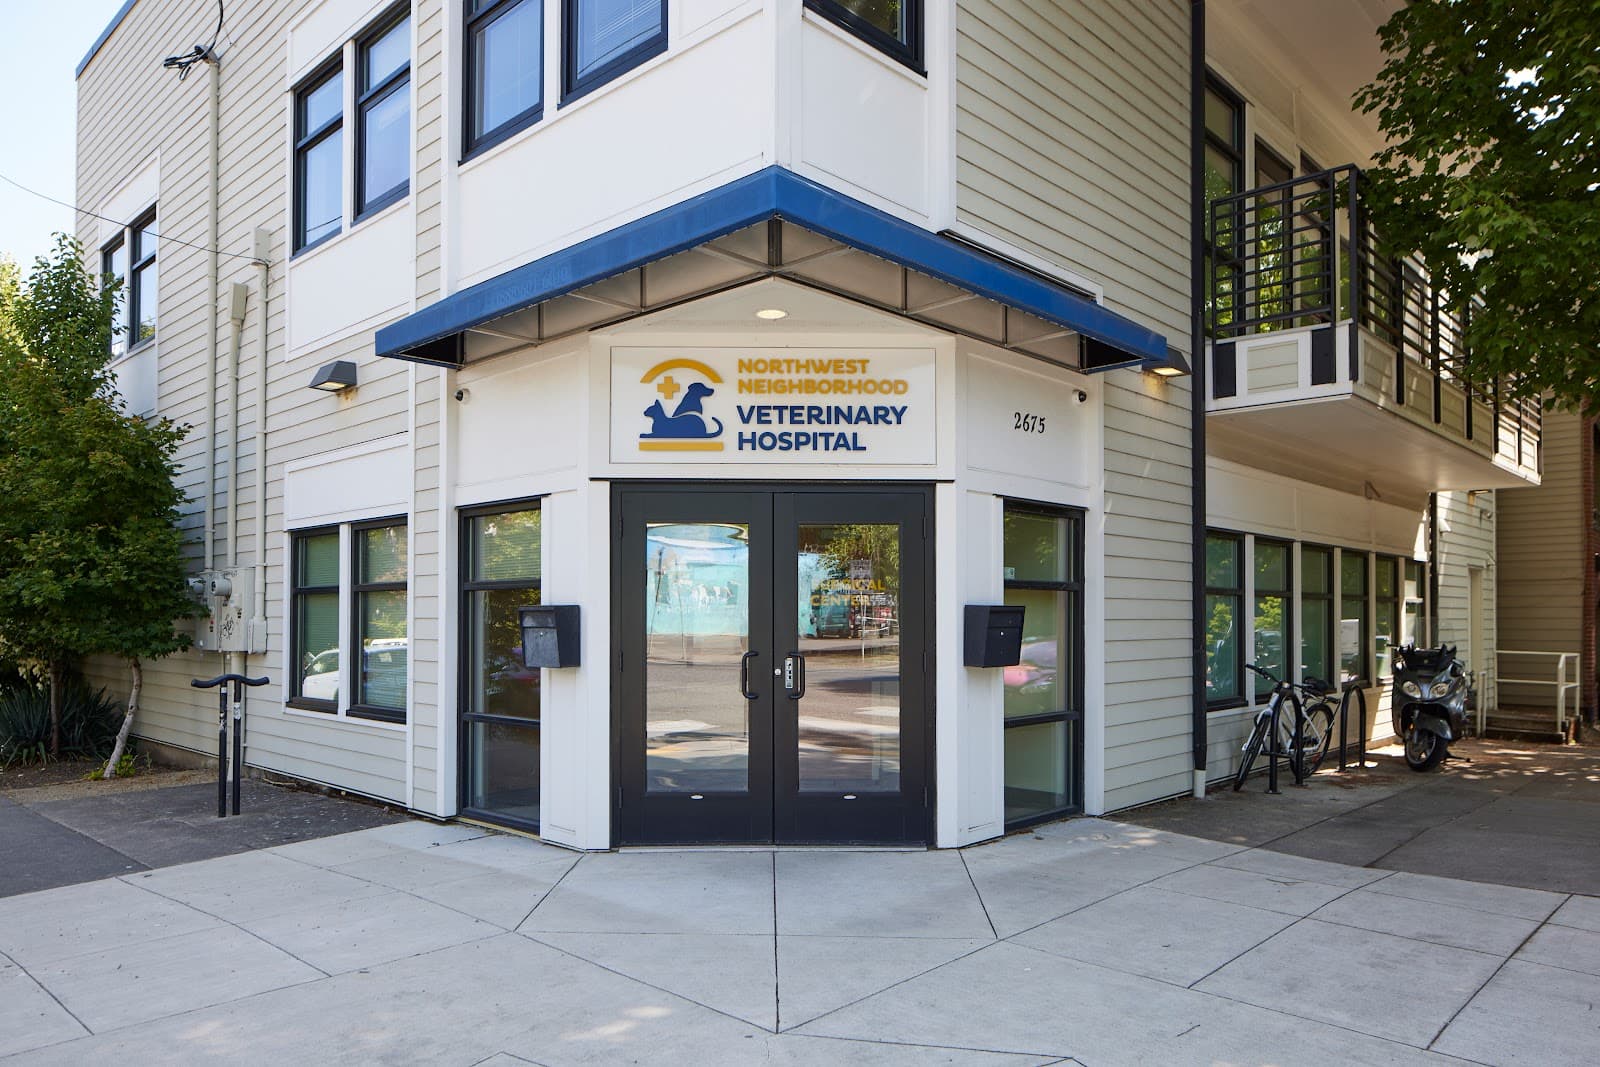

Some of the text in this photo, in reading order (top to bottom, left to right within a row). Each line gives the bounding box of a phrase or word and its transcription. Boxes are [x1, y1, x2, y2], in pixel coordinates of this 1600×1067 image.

[738, 359, 870, 374] NORTHWEST
[738, 379, 909, 395] NEIGHBORHOOD
[736, 405, 908, 425] VETERINARY
[1014, 411, 1046, 434] 2675
[737, 431, 867, 451] HOSPITAL
[811, 578, 886, 591] URGICAL
[810, 594, 872, 607] CENTER
